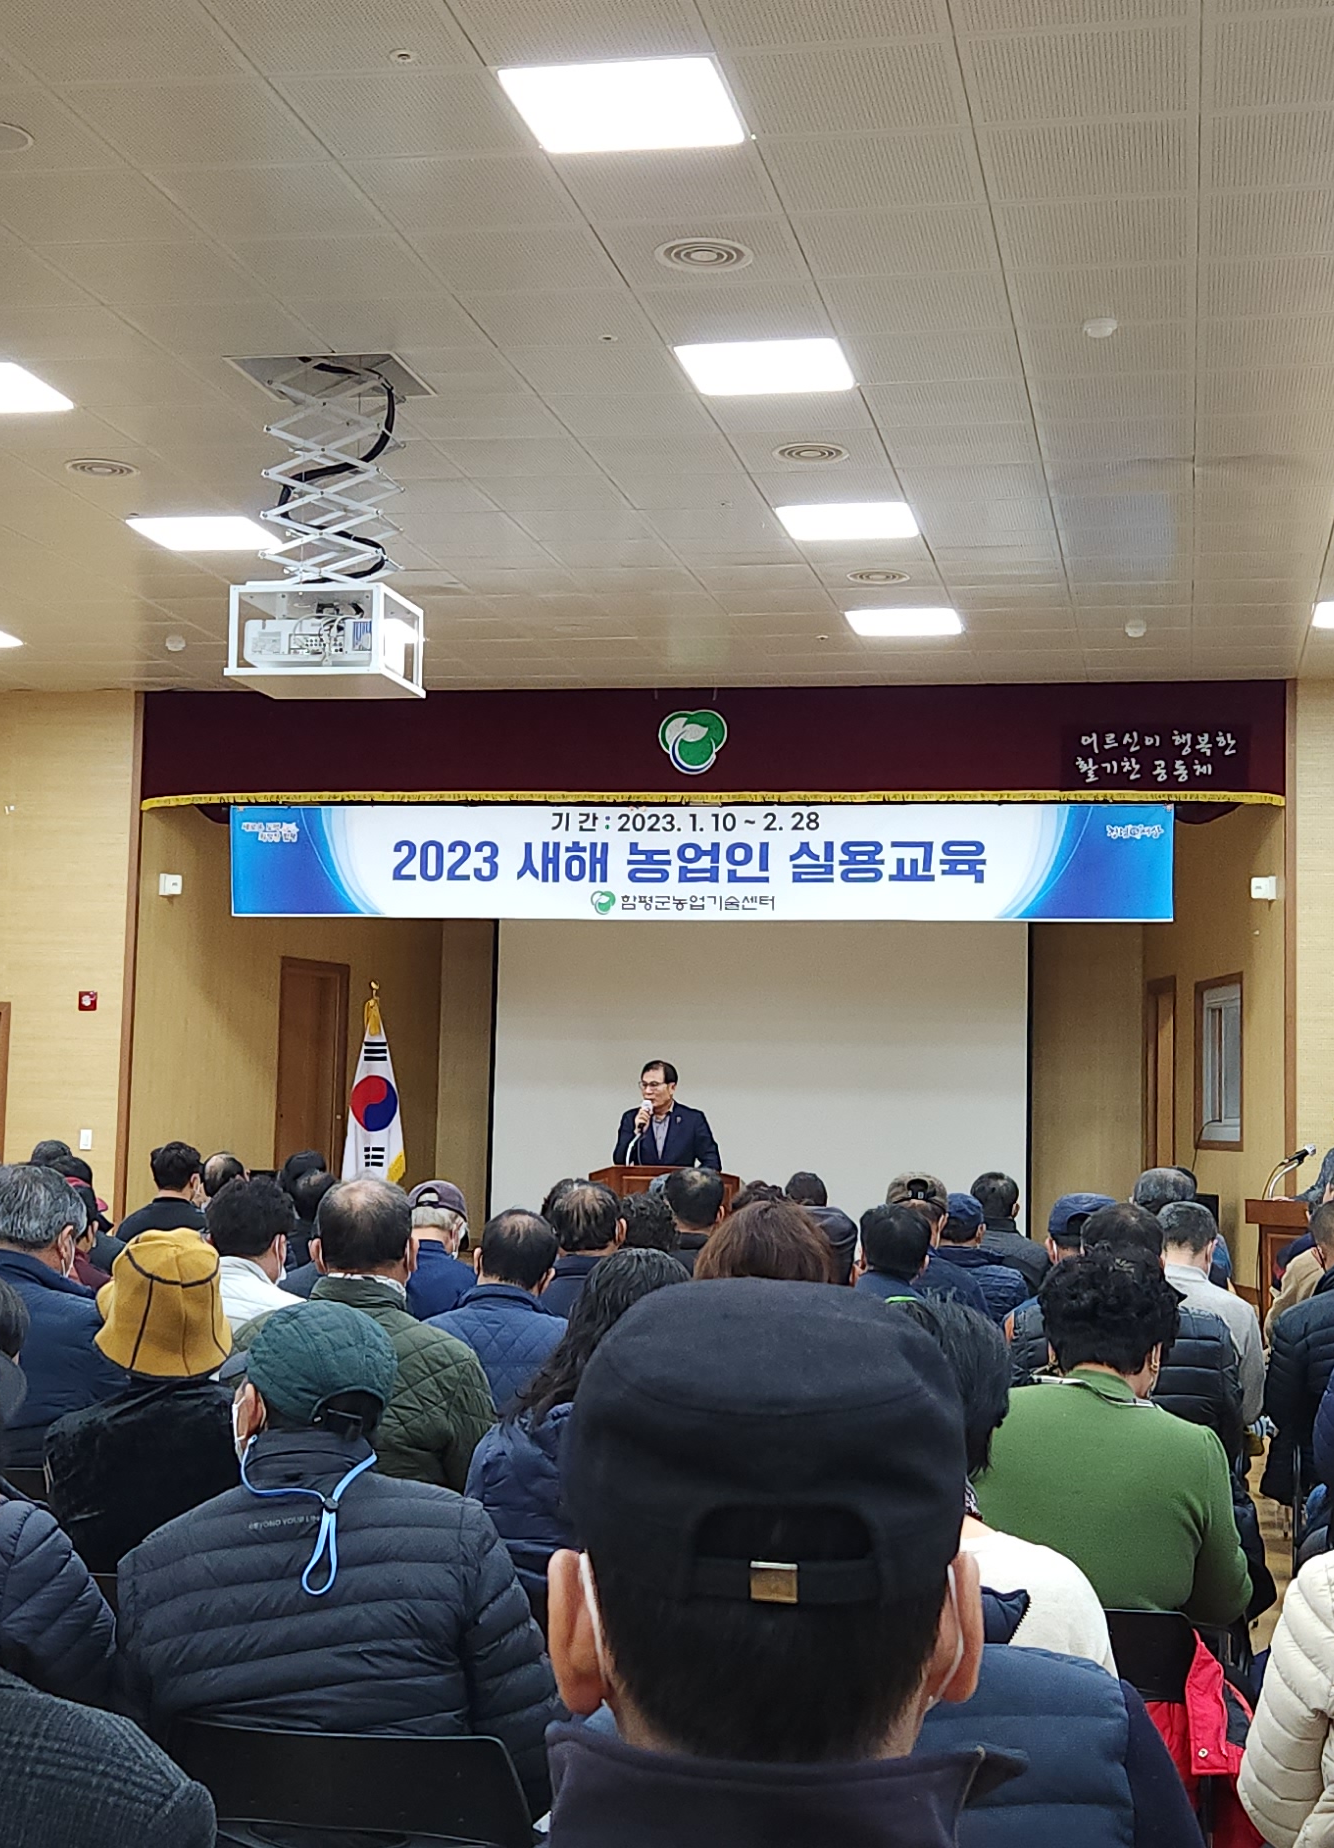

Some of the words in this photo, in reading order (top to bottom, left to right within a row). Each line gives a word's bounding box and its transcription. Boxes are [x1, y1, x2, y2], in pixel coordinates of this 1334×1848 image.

[1080, 731, 1160, 754] 어르신이
[1171, 730, 1236, 756] 행복한
[1075, 756, 1141, 783] 활기찬
[1152, 759, 1212, 782] 공동체
[711, 812, 737, 832] 10
[791, 811, 820, 831] 28
[392, 839, 499, 882] 2023
[516, 840, 609, 883] 새해
[626, 841, 770, 884] 농업인
[789, 840, 987, 884] 실용교육
[621, 894, 775, 911] 함평군농업기술센터
